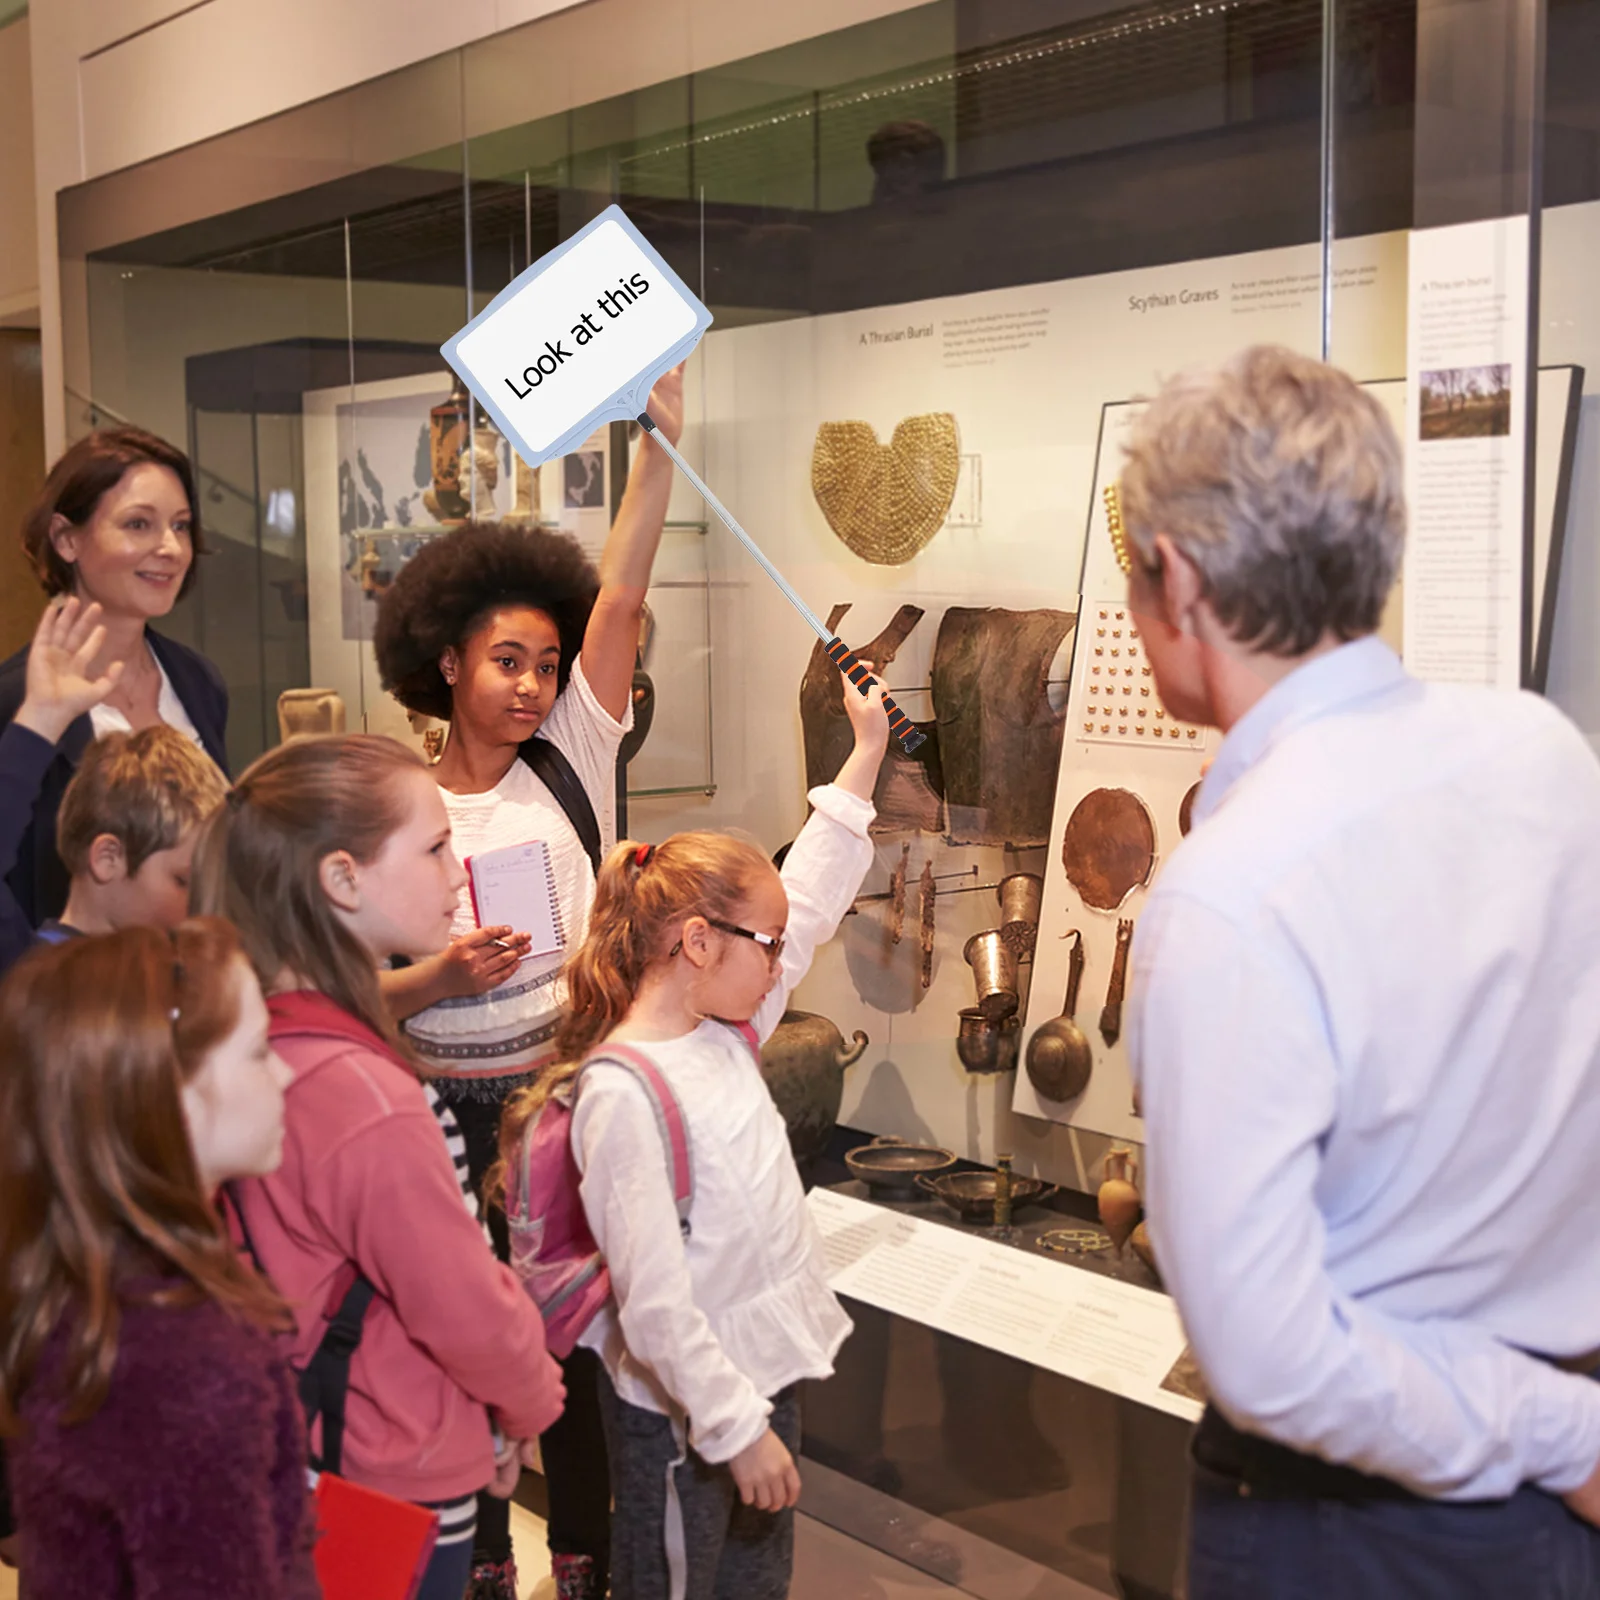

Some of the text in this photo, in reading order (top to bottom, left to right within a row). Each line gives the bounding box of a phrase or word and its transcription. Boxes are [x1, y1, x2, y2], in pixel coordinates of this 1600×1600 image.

[1128, 292, 1177, 314] Scythian
[1179, 288, 1220, 305] Graves
[504, 272, 650, 400] Look at this
[859, 323, 934, 345] A Thracian Burial
